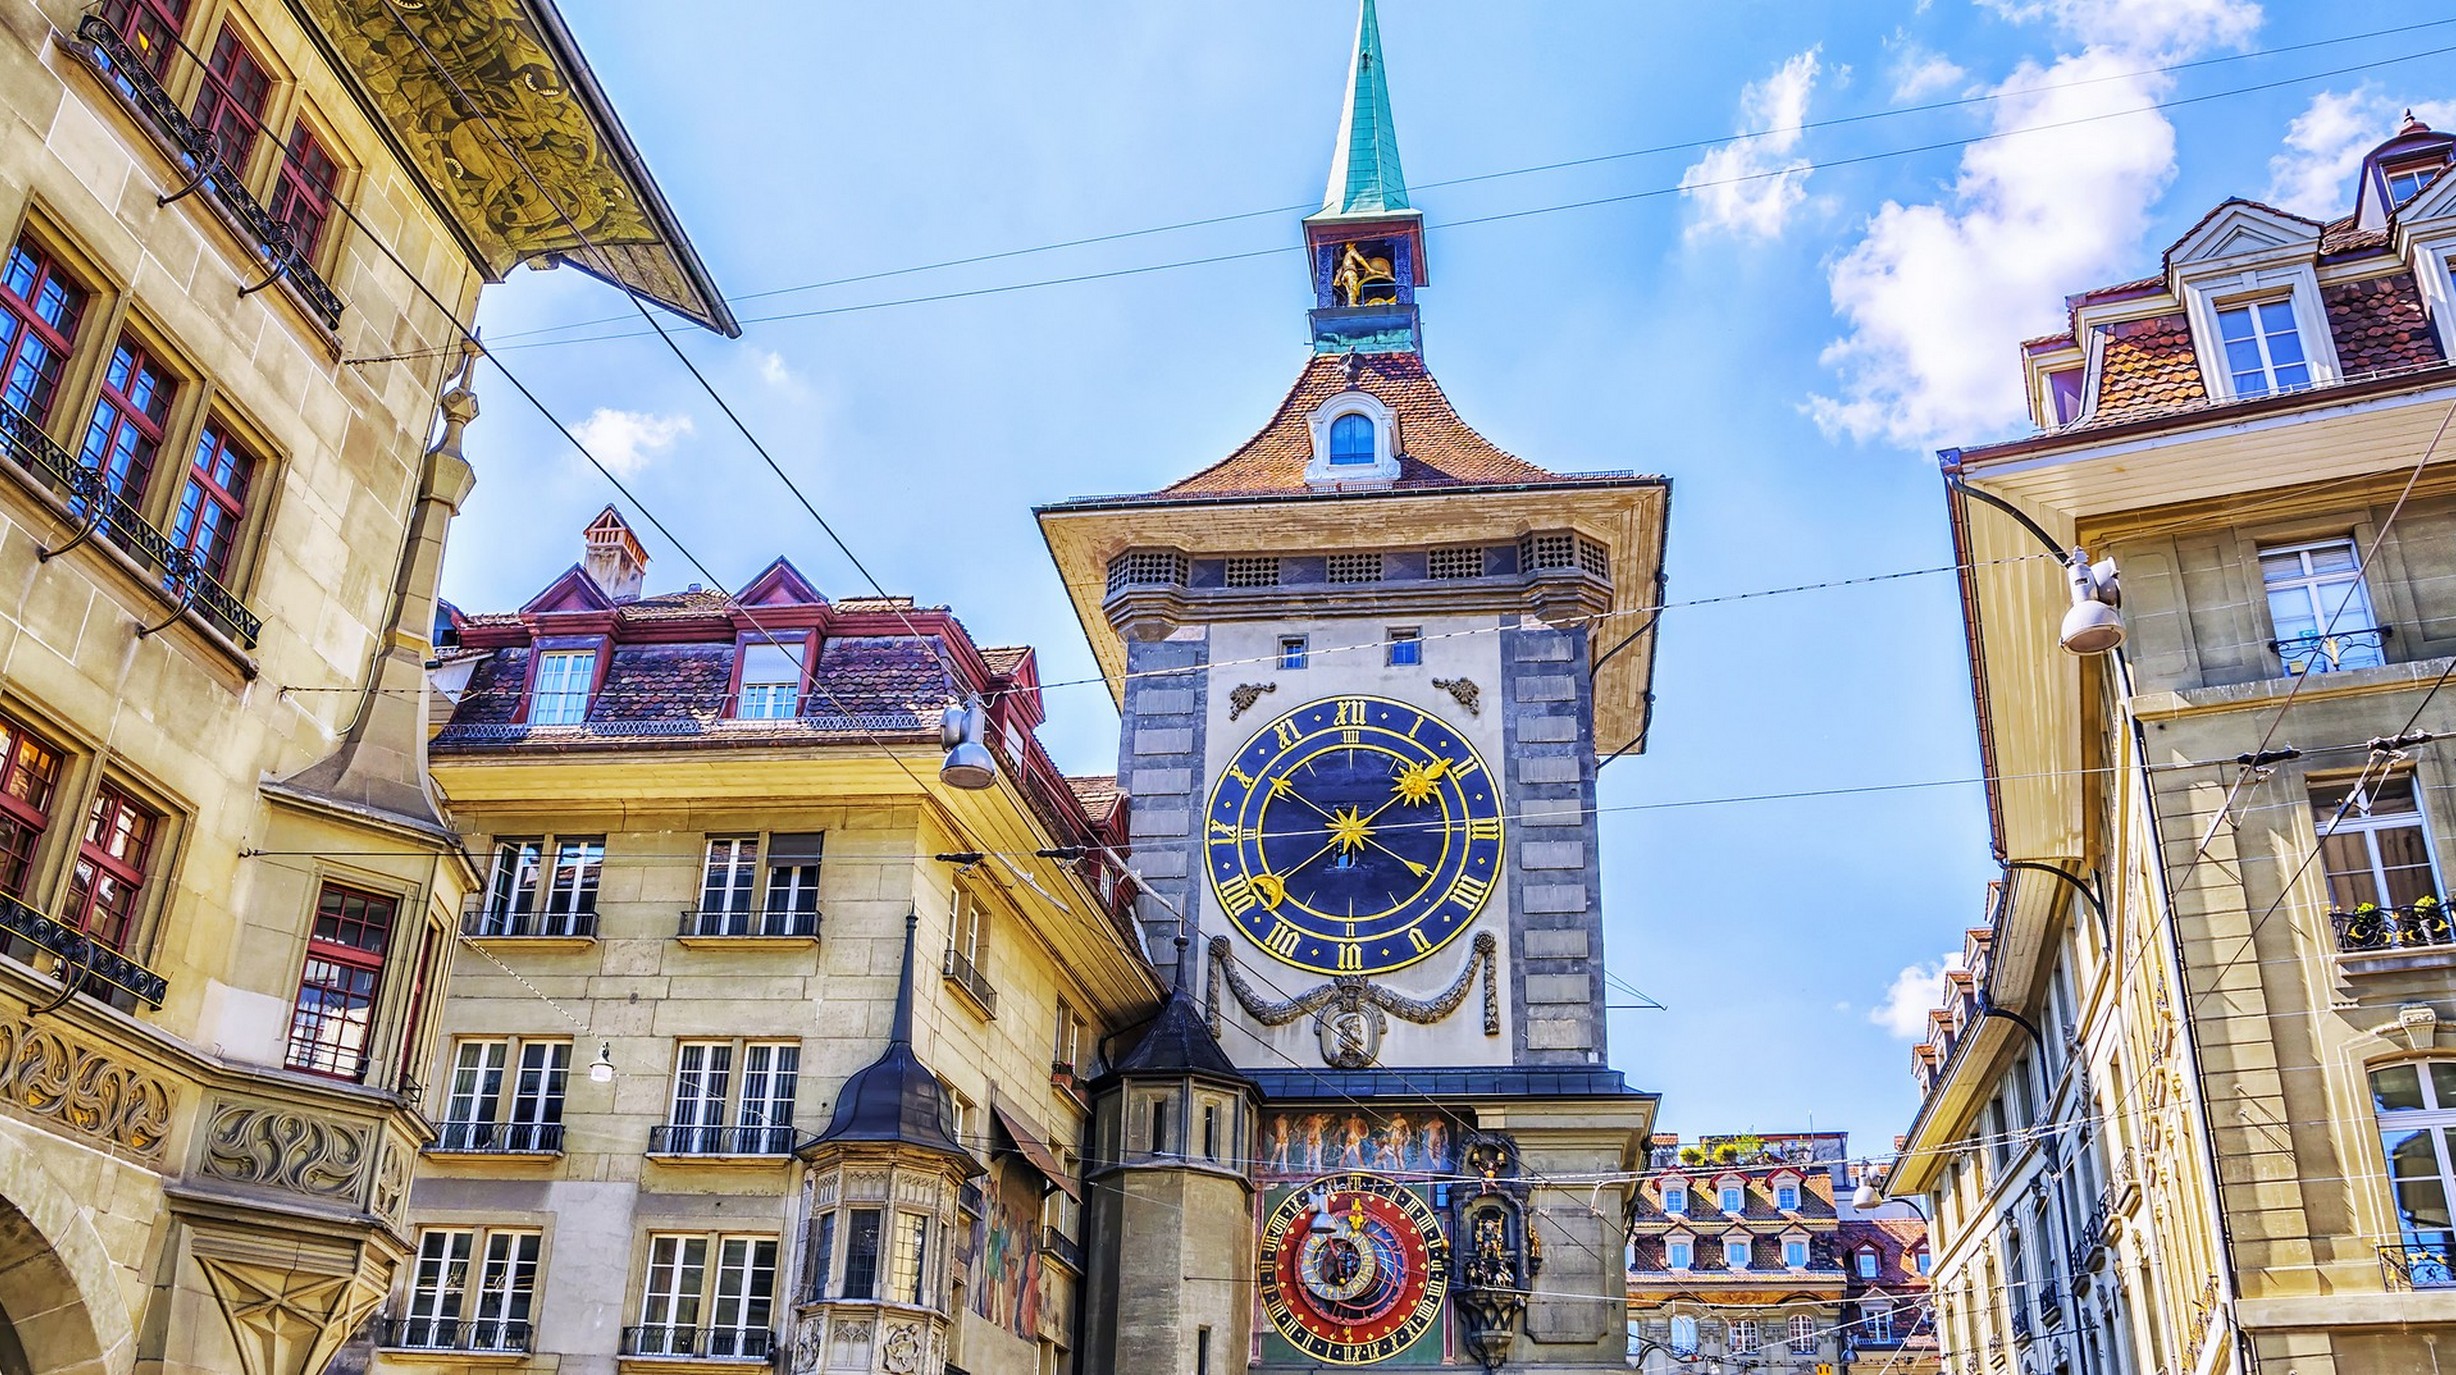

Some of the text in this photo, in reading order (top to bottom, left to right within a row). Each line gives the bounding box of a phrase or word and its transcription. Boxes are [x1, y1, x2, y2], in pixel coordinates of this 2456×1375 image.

[1333, 700, 1366, 726] XII
[1273, 718, 1302, 749] XI
[1409, 715, 1424, 738] I
[1230, 764, 1253, 789] X
[1452, 755, 1479, 780] II
[1210, 818, 1237, 844] IX
[1470, 817, 1499, 840] III
[1219, 873, 1257, 917] VIII
[1449, 873, 1487, 911] IIII
[1264, 922, 1300, 958] VII
[1408, 928, 1432, 953] V
[1338, 944, 1363, 970] VI
